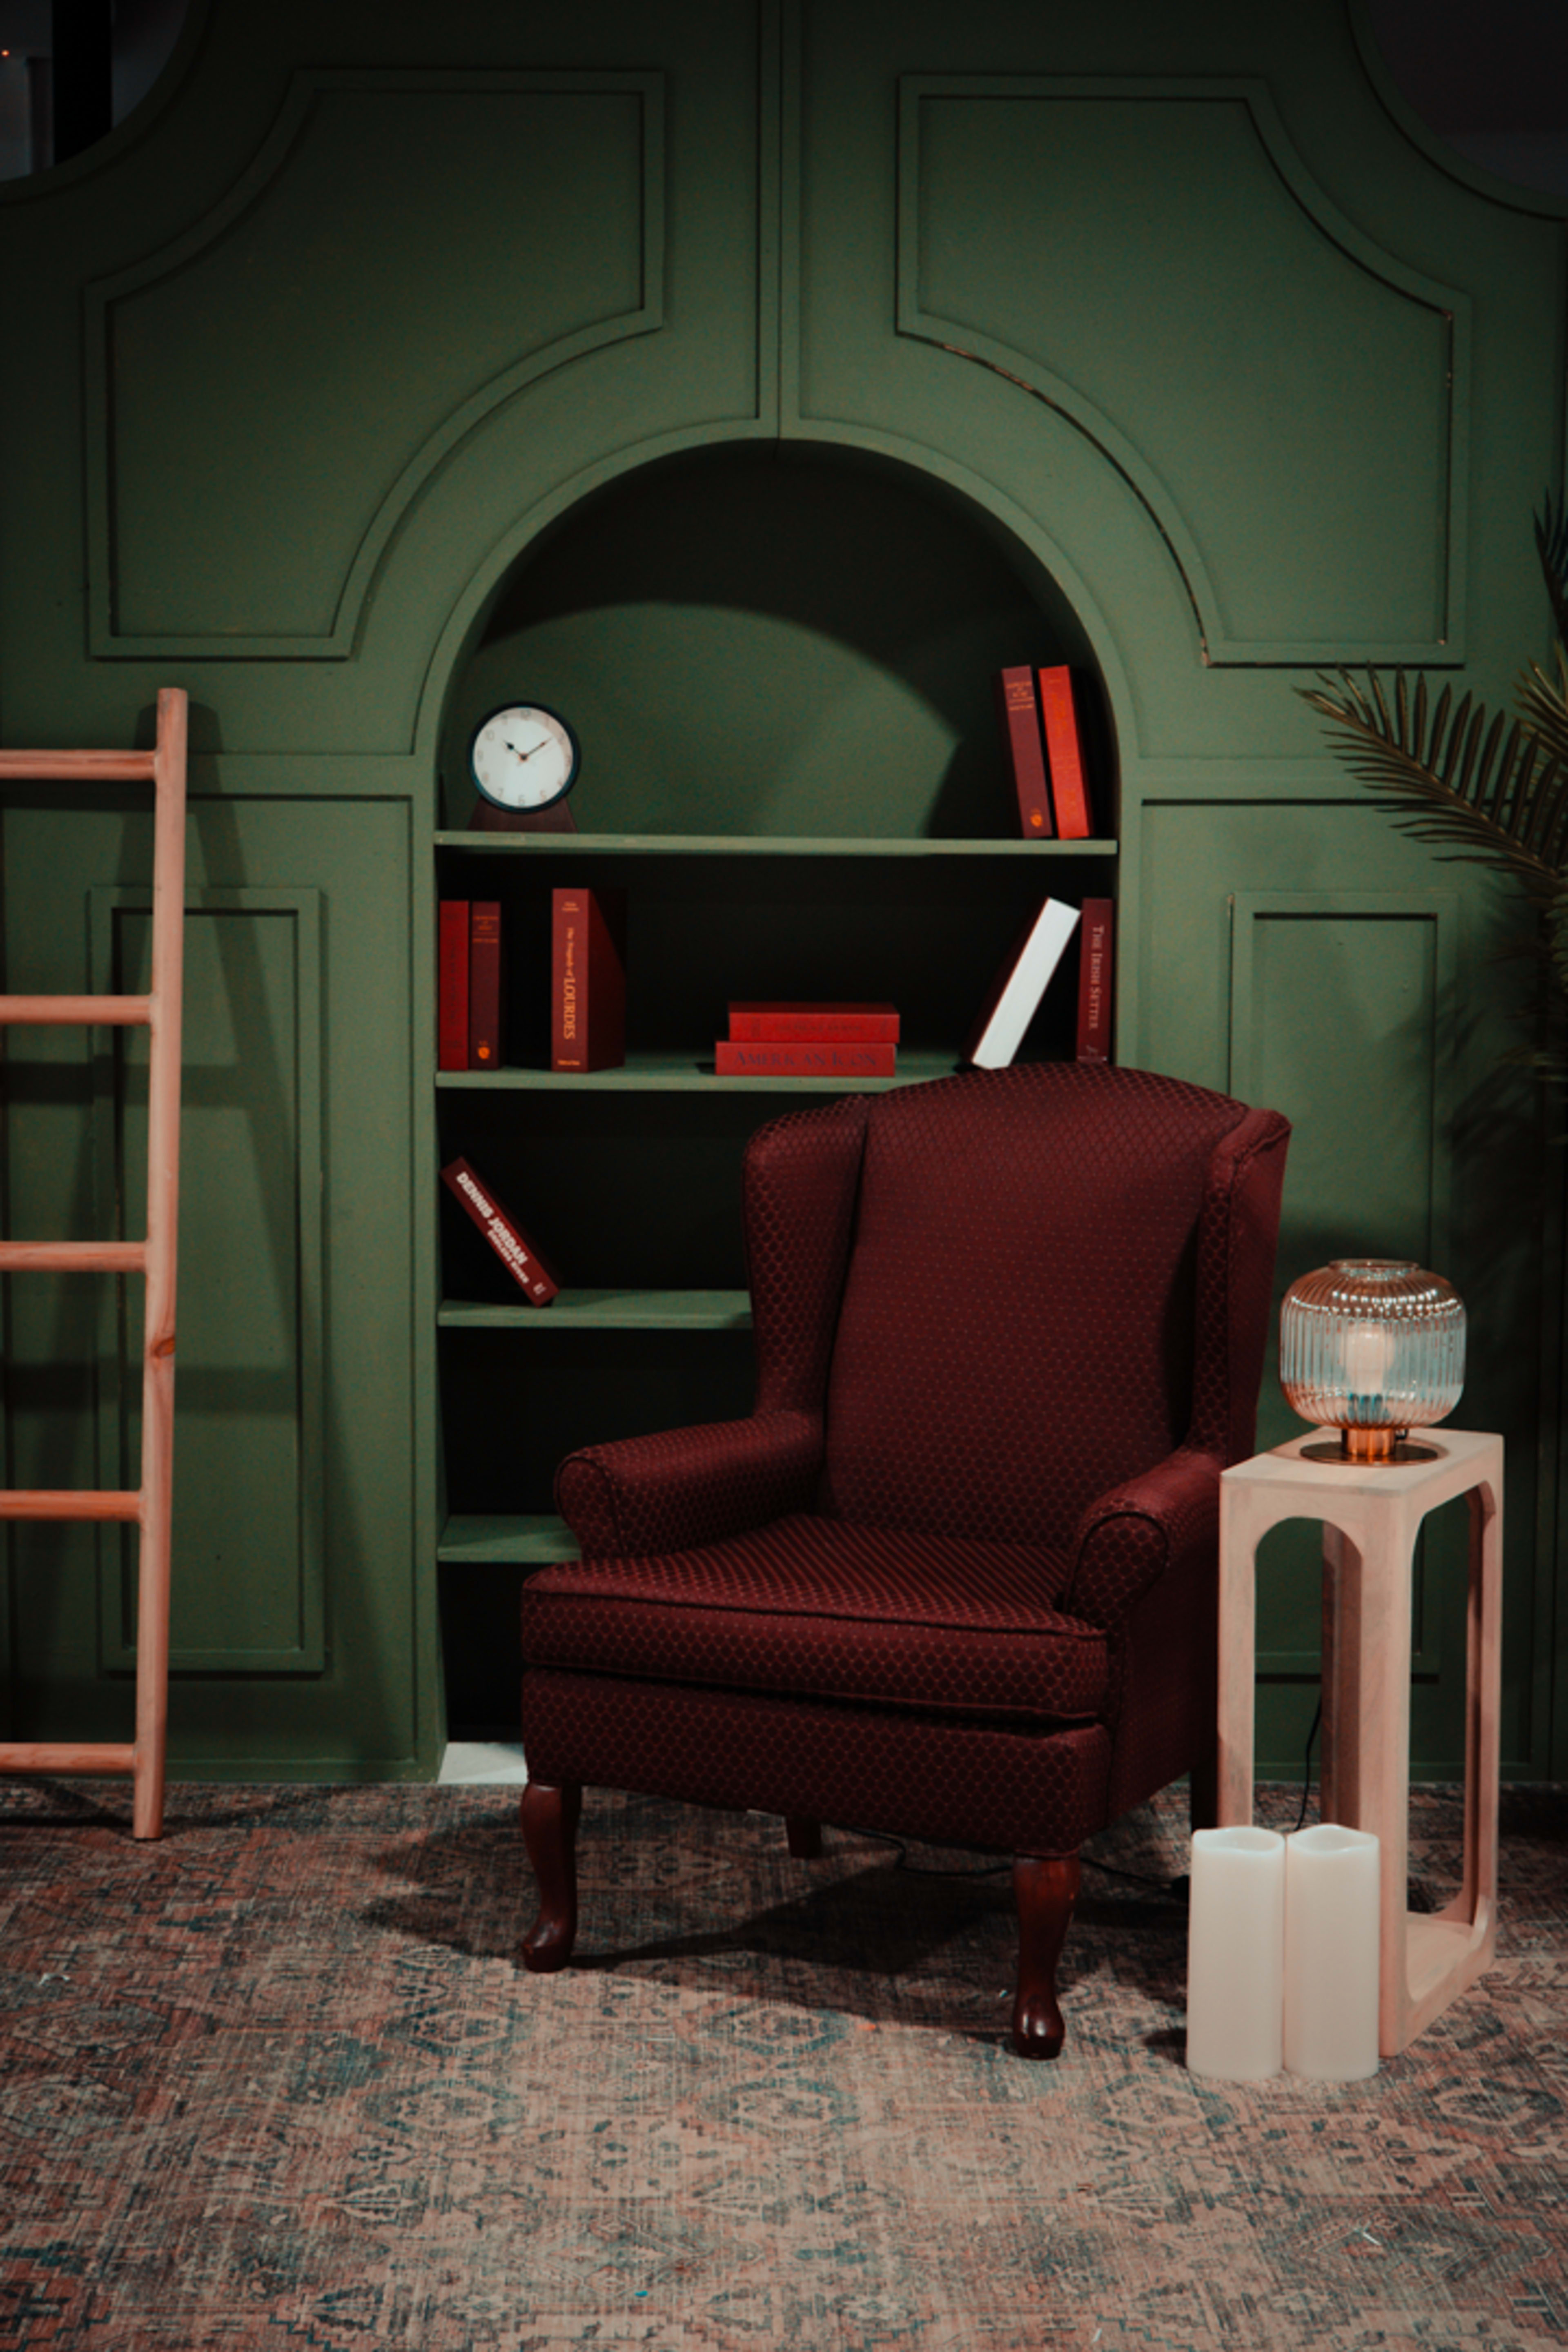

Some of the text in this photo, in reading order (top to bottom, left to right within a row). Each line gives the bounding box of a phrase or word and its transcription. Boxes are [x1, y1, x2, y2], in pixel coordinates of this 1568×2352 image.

[564, 978, 576, 1039] LOURDES
[1089, 925, 1104, 1029] THE IRISH SETTER
[457, 1172, 528, 1264] DENNIS JORDAN
